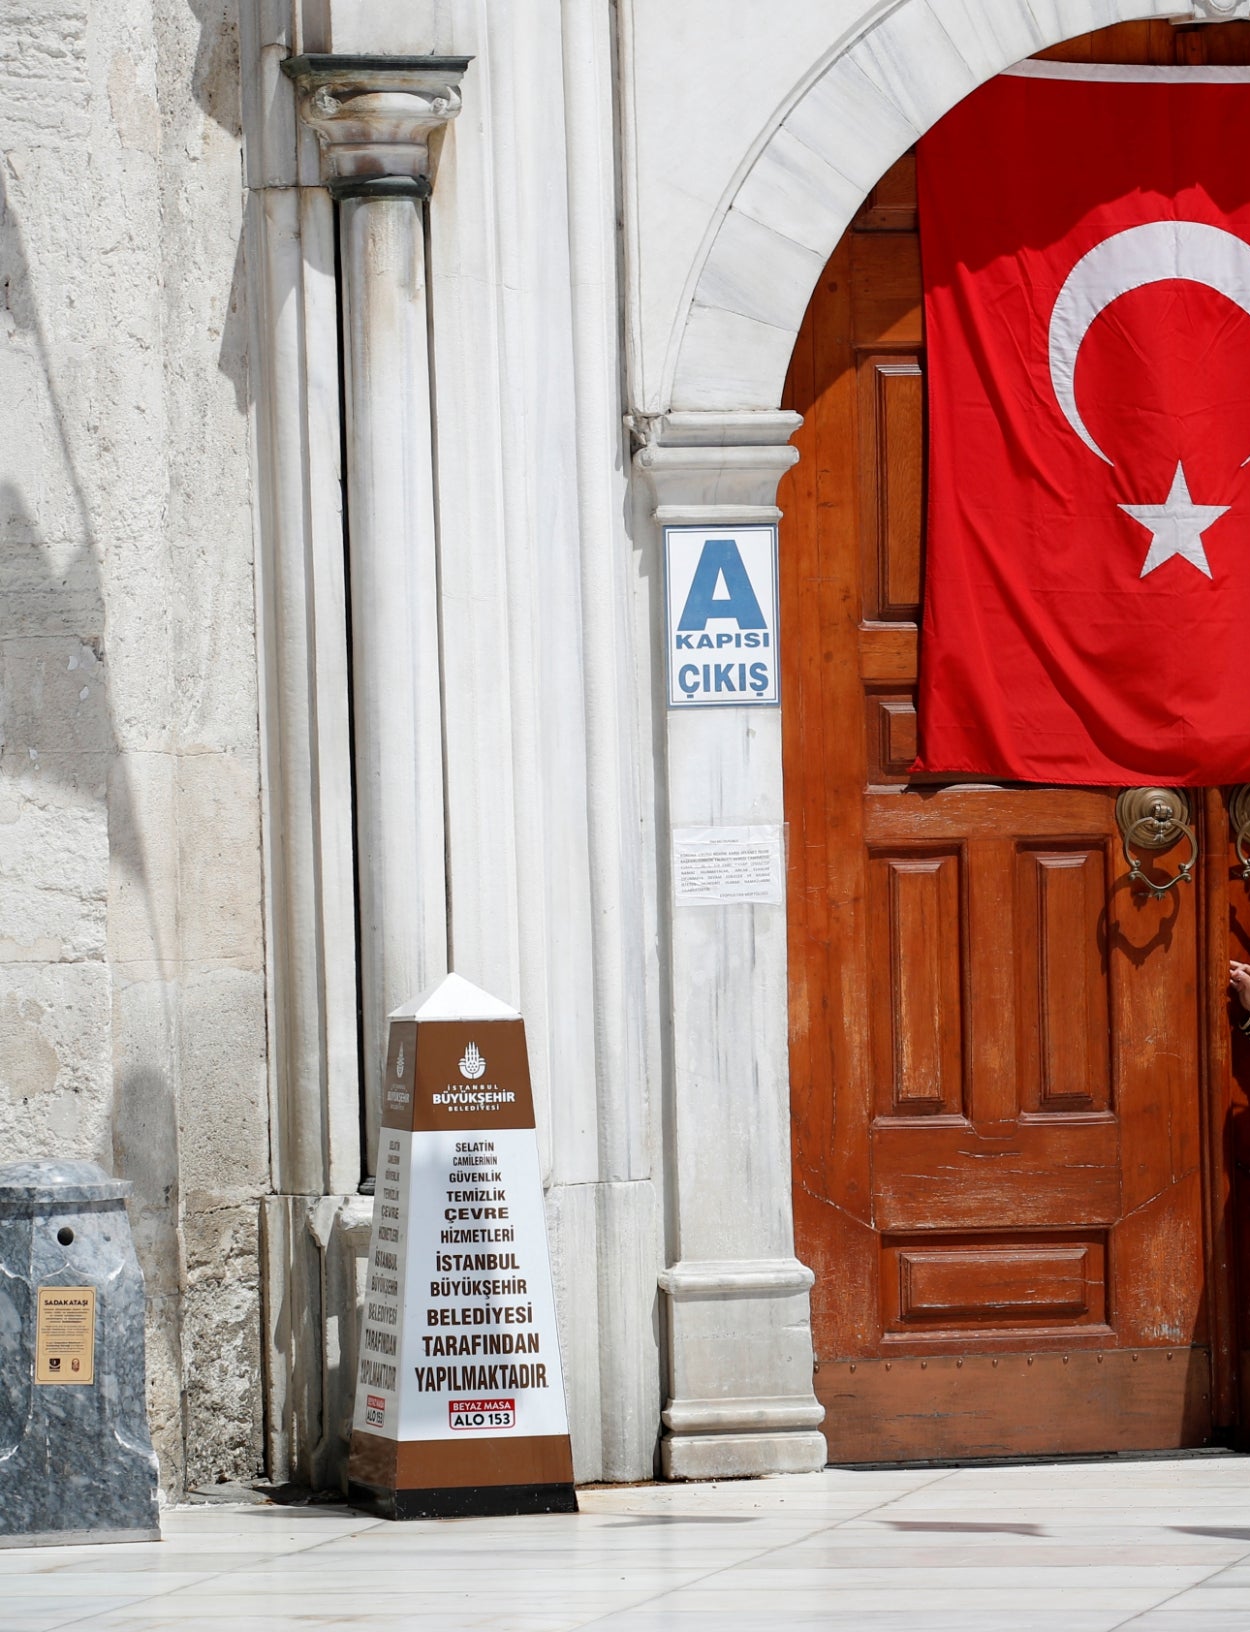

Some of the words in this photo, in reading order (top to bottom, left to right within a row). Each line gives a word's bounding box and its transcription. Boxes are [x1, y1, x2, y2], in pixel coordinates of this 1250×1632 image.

[677, 540, 768, 631] A
[675, 632, 769, 649] KAPISI
[678, 661, 769, 698] ÇIKIŞ
[447, 1083, 499, 1091] İSTANBUL
[432, 1089, 516, 1106] BÜYÜKŞEHİR
[448, 1104, 500, 1112] BELEDİYESİ
[455, 1139, 495, 1152] SELATİN
[452, 1153, 498, 1167] CAMİLERİNİN
[449, 1169, 502, 1183] GÜVENLİK
[446, 1187, 506, 1202] TEMİZLİK
[444, 1207, 509, 1224] ÇEVRE
[441, 1225, 515, 1244] HİZMETLERİ
[436, 1250, 520, 1272] İSTANBUL
[430, 1275, 527, 1300] BÜYÜKŞEHİR
[427, 1301, 533, 1326] BELEDİYESİ
[422, 1333, 540, 1357] TARAFINDAN
[452, 1402, 482, 1411] BEYAZ
[484, 1401, 511, 1410] MASA
[454, 1413, 485, 1427] ALO
[488, 1412, 511, 1425] 153
